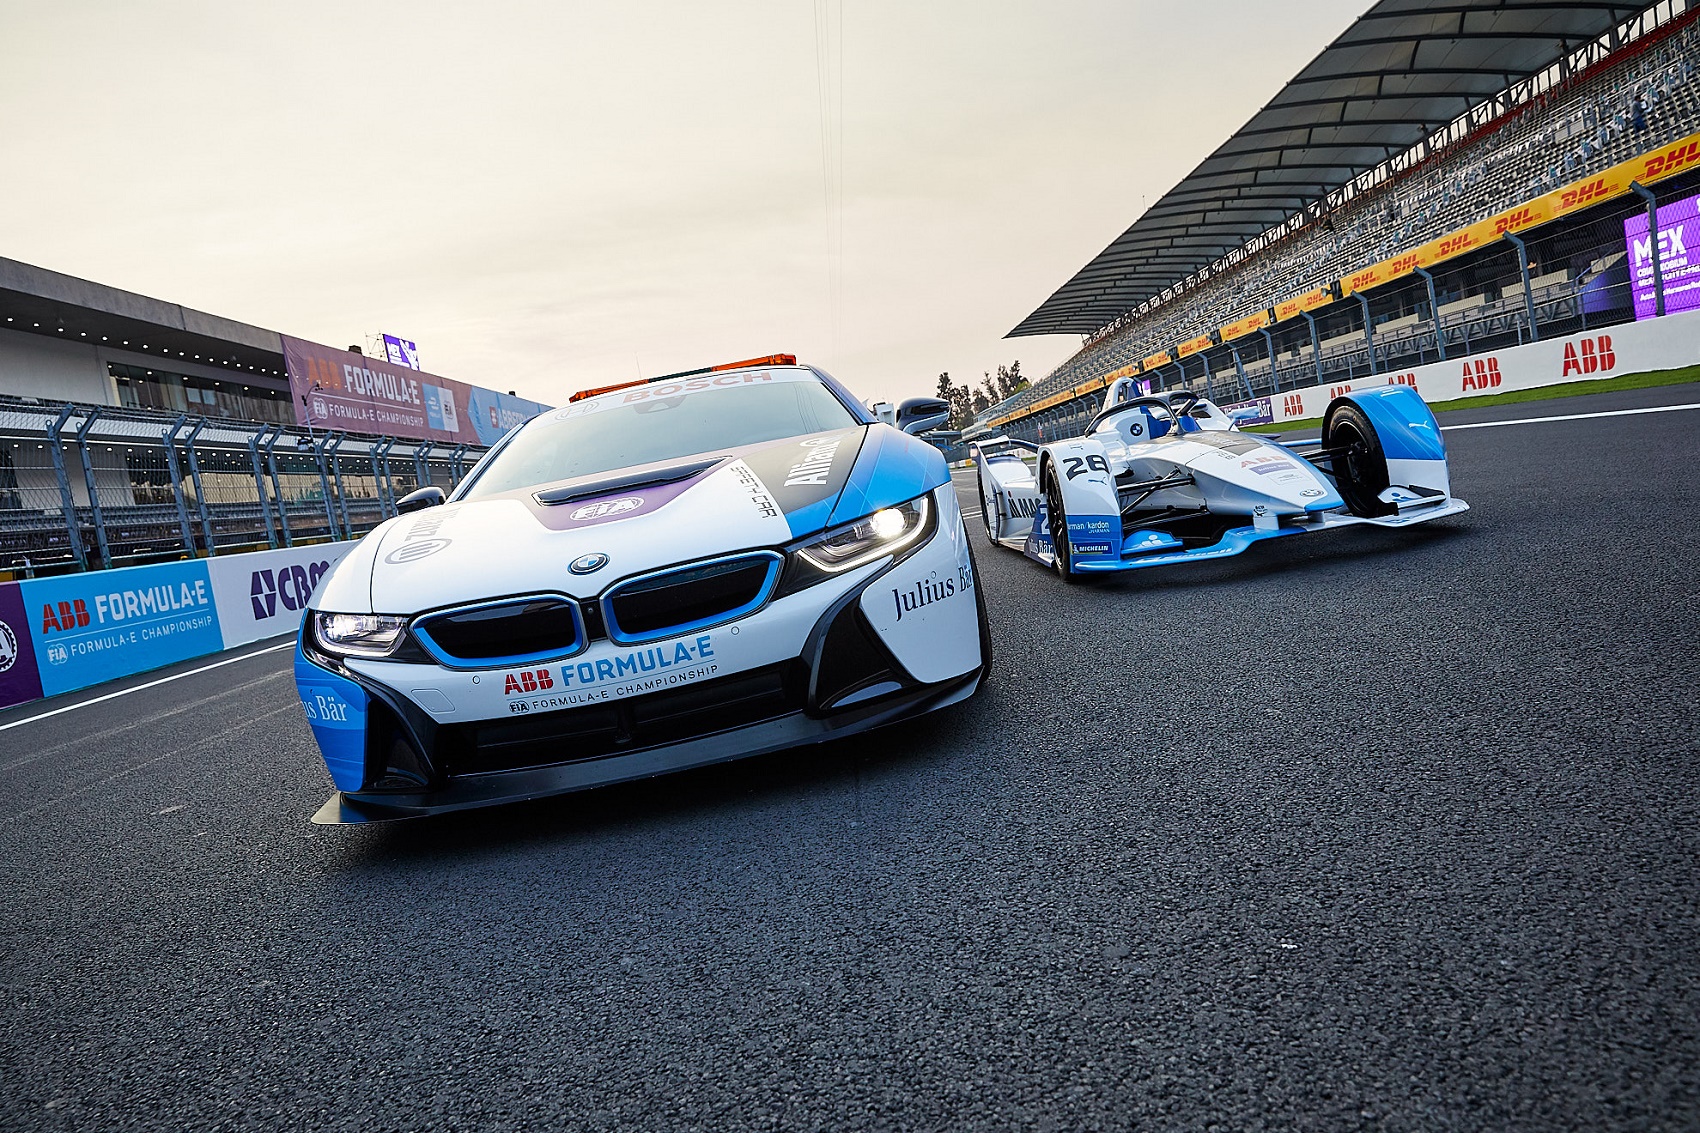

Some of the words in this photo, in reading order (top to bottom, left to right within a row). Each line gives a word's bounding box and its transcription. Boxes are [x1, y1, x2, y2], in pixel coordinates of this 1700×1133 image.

[1643, 141, 1700, 178] DHL
[1560, 178, 1609, 209] DHL
[1494, 208, 1534, 234] DHL
[1440, 233, 1472, 256] DHL
[1633, 224, 1686, 268] MEX
[1392, 254, 1420, 274] DHL
[1352, 271, 1377, 289] DHL
[1562, 334, 1616, 377] ABB
[308, 356, 341, 390] ABB
[343, 364, 421, 405] FORMULA-E
[623, 371, 772, 403] BOSCH
[1462, 357, 1502, 391] ABB
[328, 404, 375, 421] FORMULA-E
[376, 410, 424, 427] CHAMPIONSHIP
[1257, 399, 1271, 418] Bär
[1284, 394, 1304, 417] ABB
[1062, 454, 1110, 481] 28
[1241, 455, 1287, 469] ABB
[572, 498, 636, 520] FIA
[751, 494, 778, 519] CAR
[1038, 539, 1053, 555] Bär
[42, 598, 91, 635] ABB
[94, 579, 209, 624] FORMULA-E
[892, 578, 955, 622] Julius
[958, 566, 973, 592] Bär
[48, 645, 68, 661] FIA
[71, 632, 136, 656] FORMULA-E
[141, 616, 213, 641] CHAMPIONSHIP
[504, 668, 554, 695] ABB
[560, 635, 714, 687] FORMULA-E
[509, 701, 529, 714] FIA
[532, 690, 609, 710] FORMULA-E
[616, 664, 719, 696] CHAMPIONSHIP
[315, 695, 347, 722] Bär
